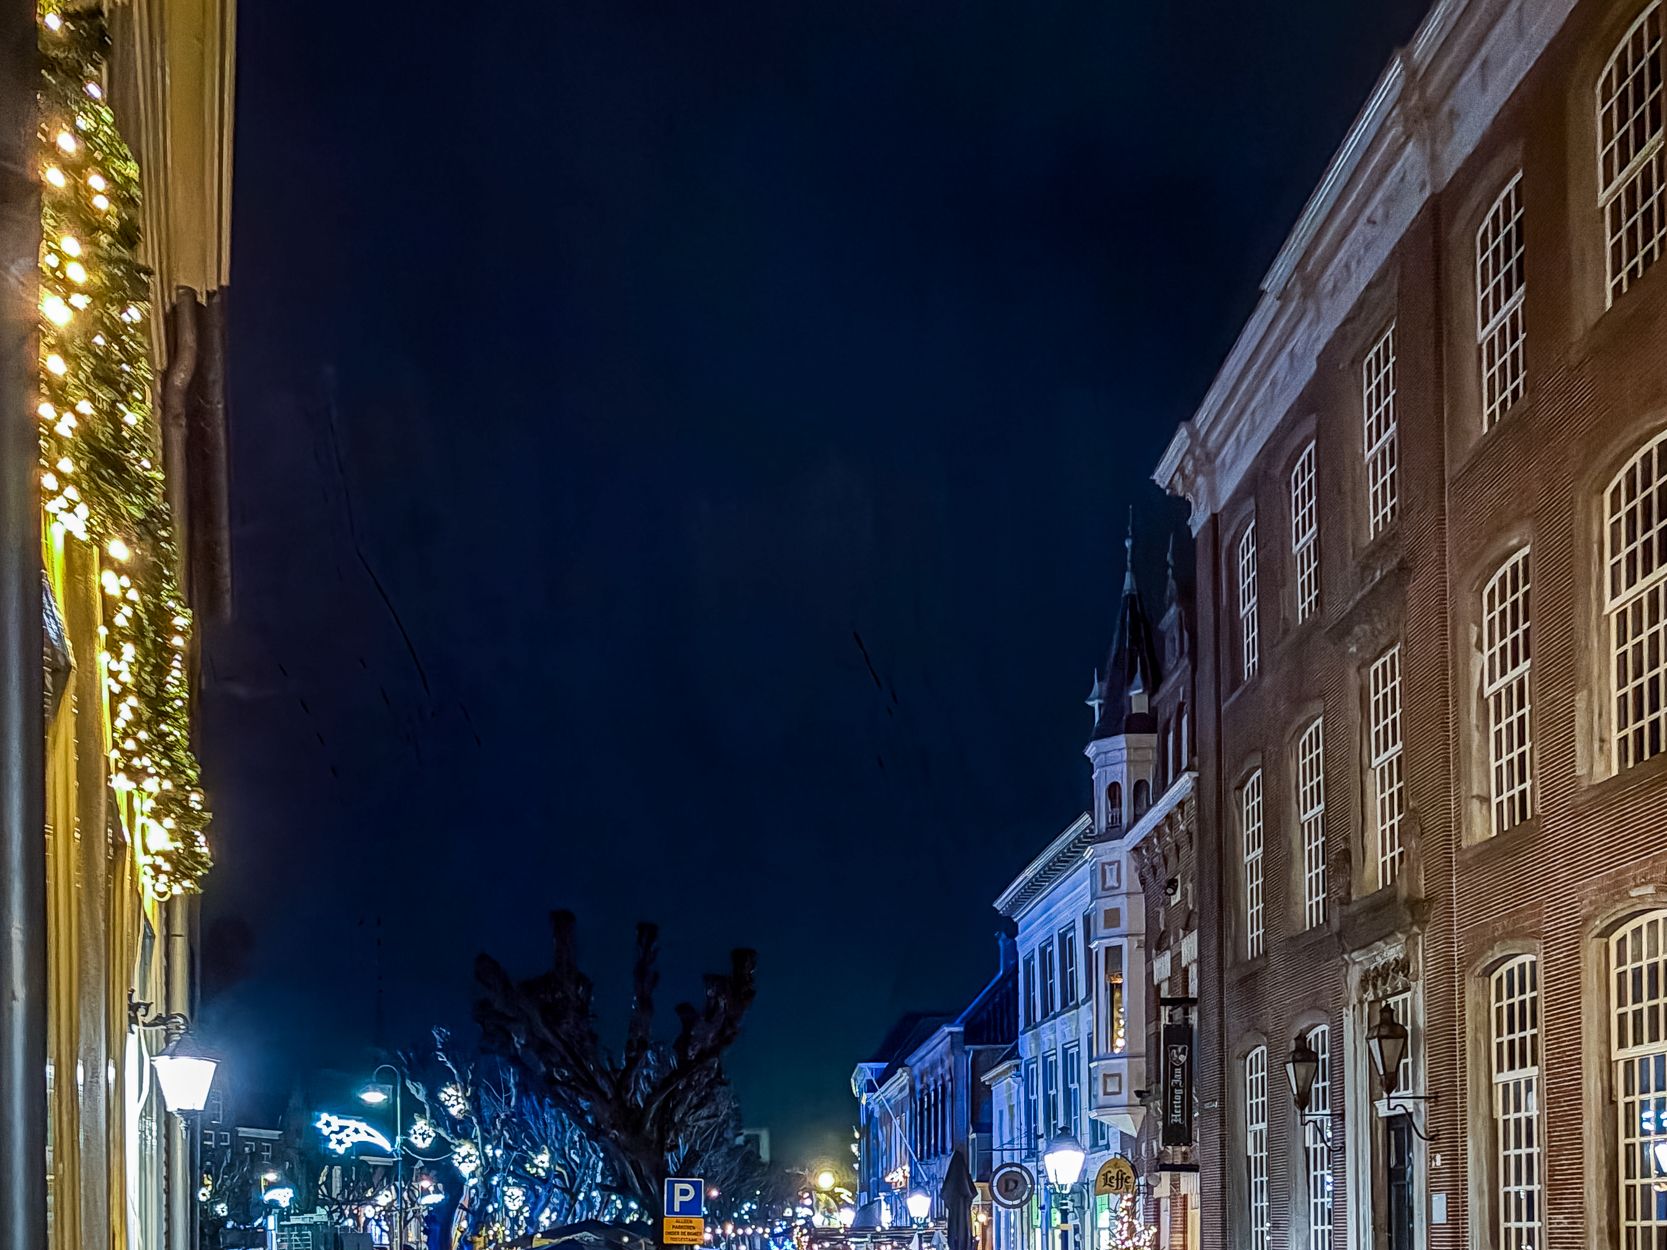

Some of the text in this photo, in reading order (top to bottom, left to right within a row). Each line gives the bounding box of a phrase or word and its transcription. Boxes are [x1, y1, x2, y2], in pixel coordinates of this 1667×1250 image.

[1171, 1067, 1184, 1125] Hertog Jan
[1003, 1178, 1019, 1193] D
[1101, 1169, 1131, 1191] Leffe
[673, 1183, 696, 1213] P
